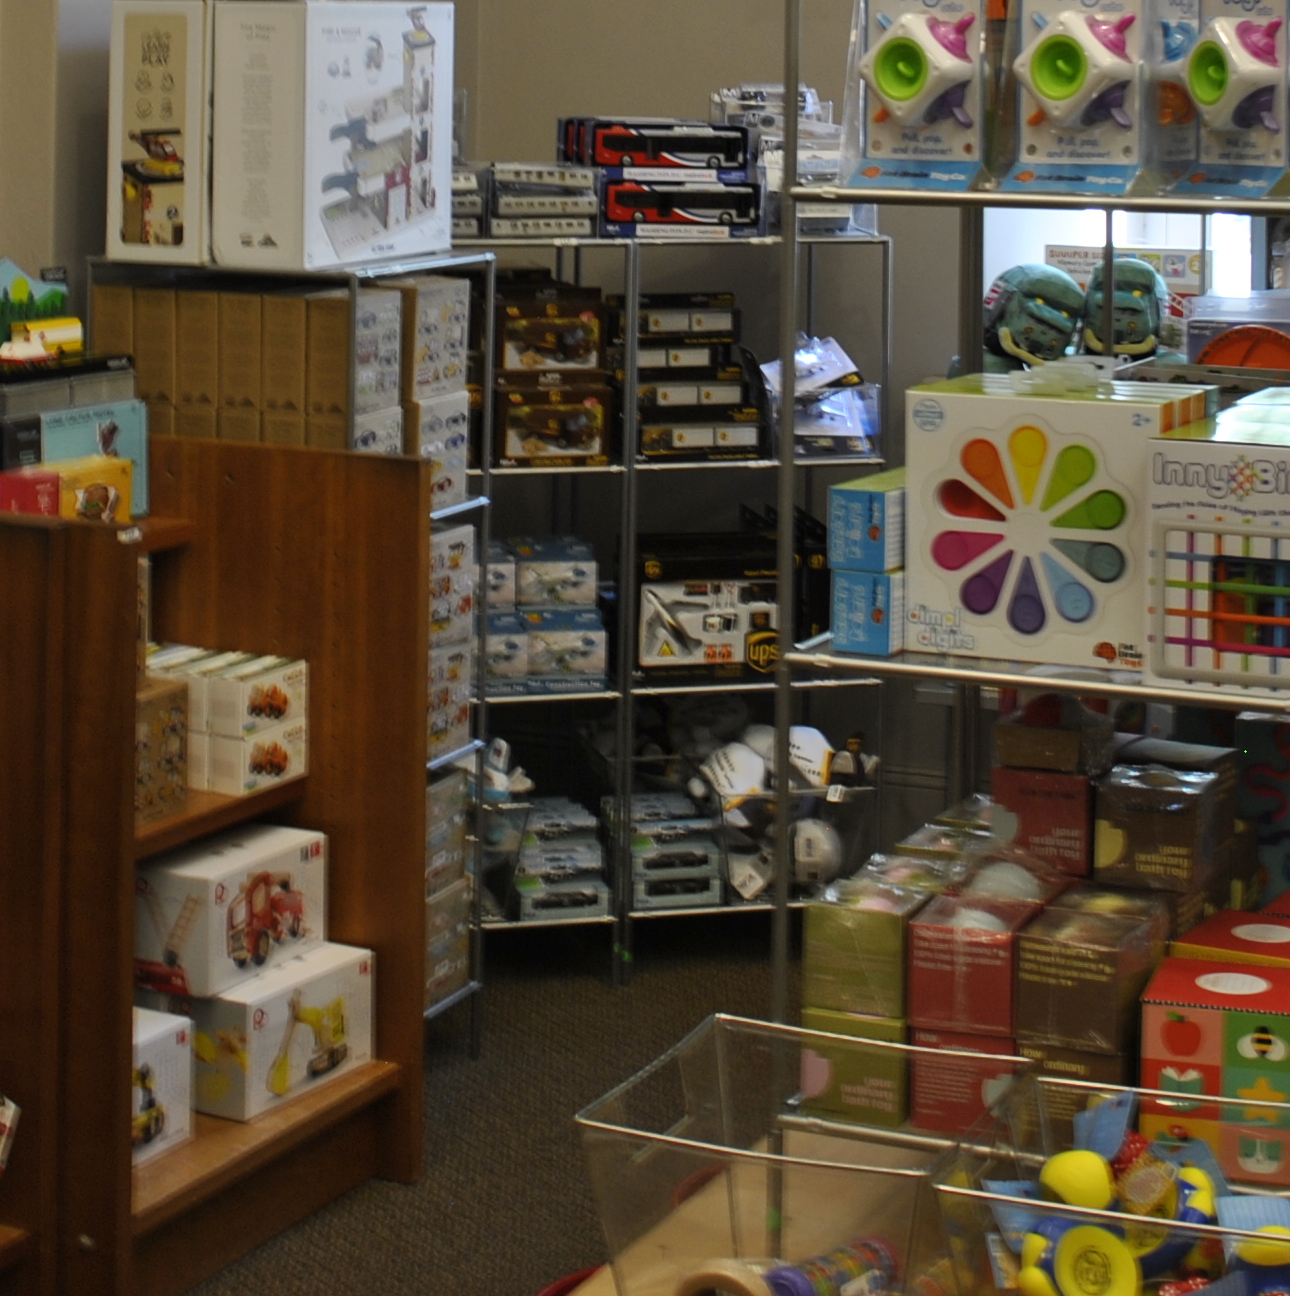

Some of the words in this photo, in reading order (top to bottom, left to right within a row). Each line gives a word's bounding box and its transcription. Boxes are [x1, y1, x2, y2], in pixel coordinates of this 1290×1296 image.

[1131, 413, 1152, 427] 2+
[1152, 452, 1229, 499] Inny
[917, 625, 975, 652] digits
[750, 644, 779, 667] ups
